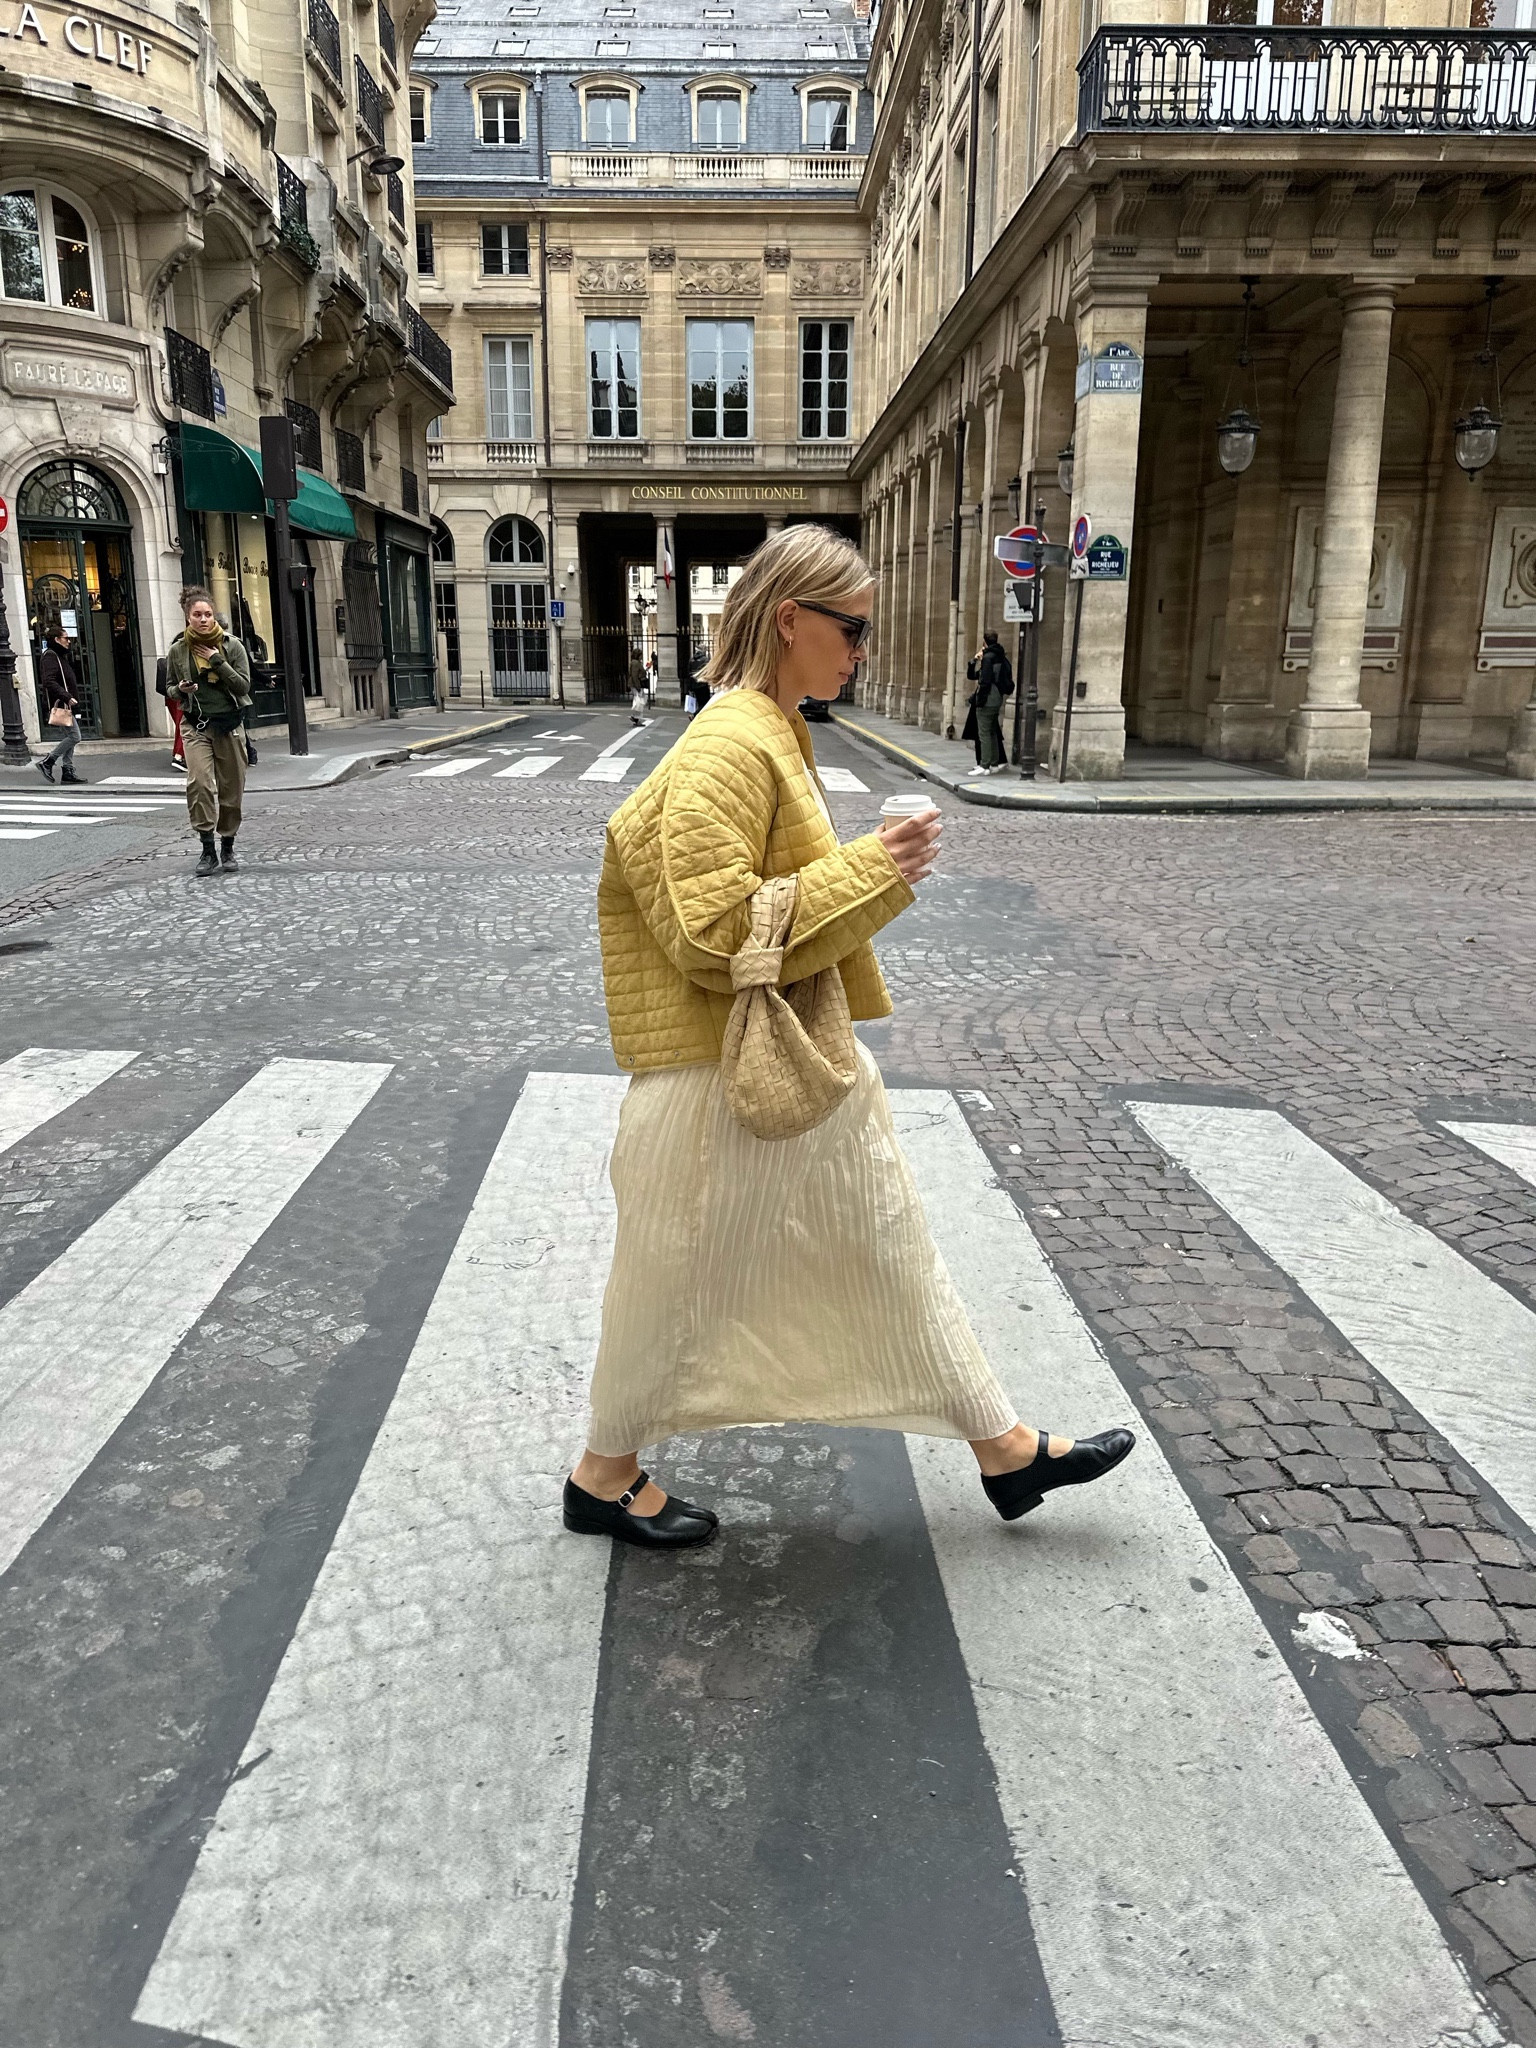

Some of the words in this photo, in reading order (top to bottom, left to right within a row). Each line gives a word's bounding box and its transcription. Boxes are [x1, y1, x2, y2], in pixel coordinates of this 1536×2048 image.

[0, 3, 48, 42] A
[65, 16, 152, 73] CLEF
[1110, 363, 1126, 371] RUE
[14, 361, 69, 385] FAURÉ
[1112, 372, 1122, 380] DE
[1096, 380, 1140, 388] RICHELIEU
[631, 486, 685, 500] CONSEIL
[691, 487, 807, 500] CONSTITUTIONNEL
